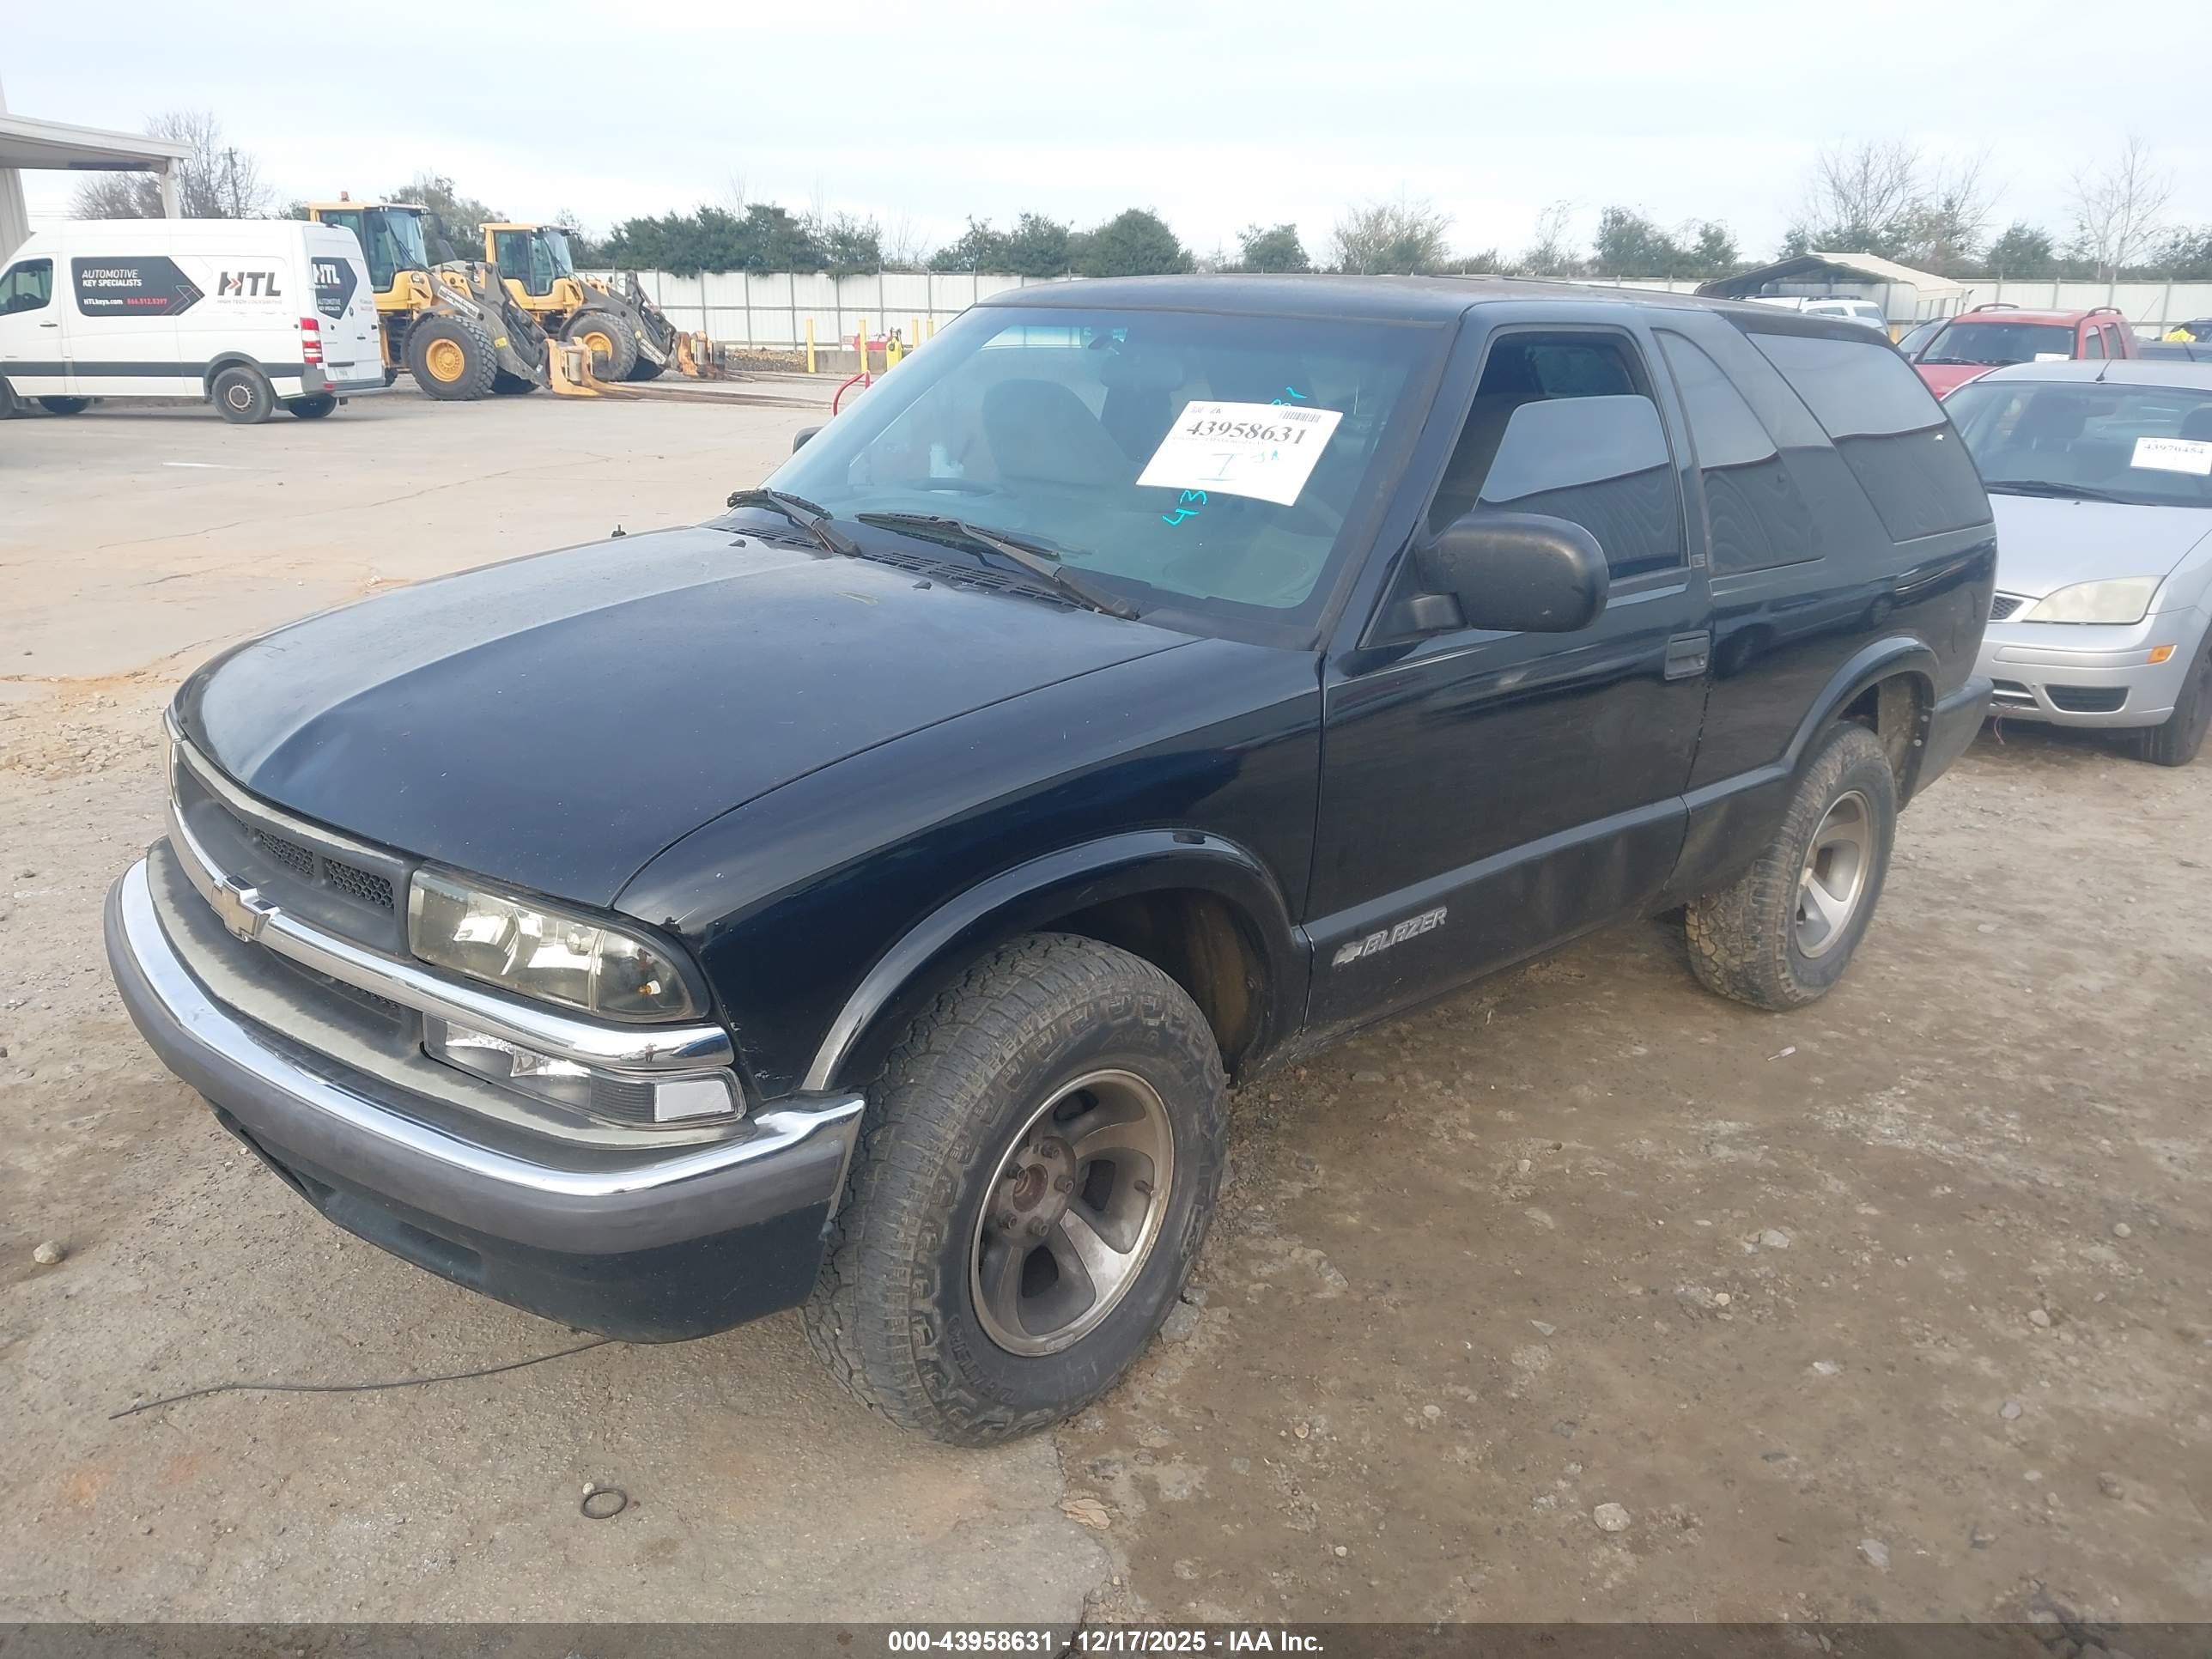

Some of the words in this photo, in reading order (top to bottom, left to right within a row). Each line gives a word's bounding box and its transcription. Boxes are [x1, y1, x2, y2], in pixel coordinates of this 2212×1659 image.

[82, 269, 138, 279] AUTOMOTIVE
[82, 279, 96, 288] KEY
[98, 279, 143, 288] SPECIALISTS
[217, 271, 282, 296] HTL
[312, 263, 341, 284] HTL
[1186, 420, 1307, 445] 43958631
[1362, 905, 1448, 957] BLAZER
